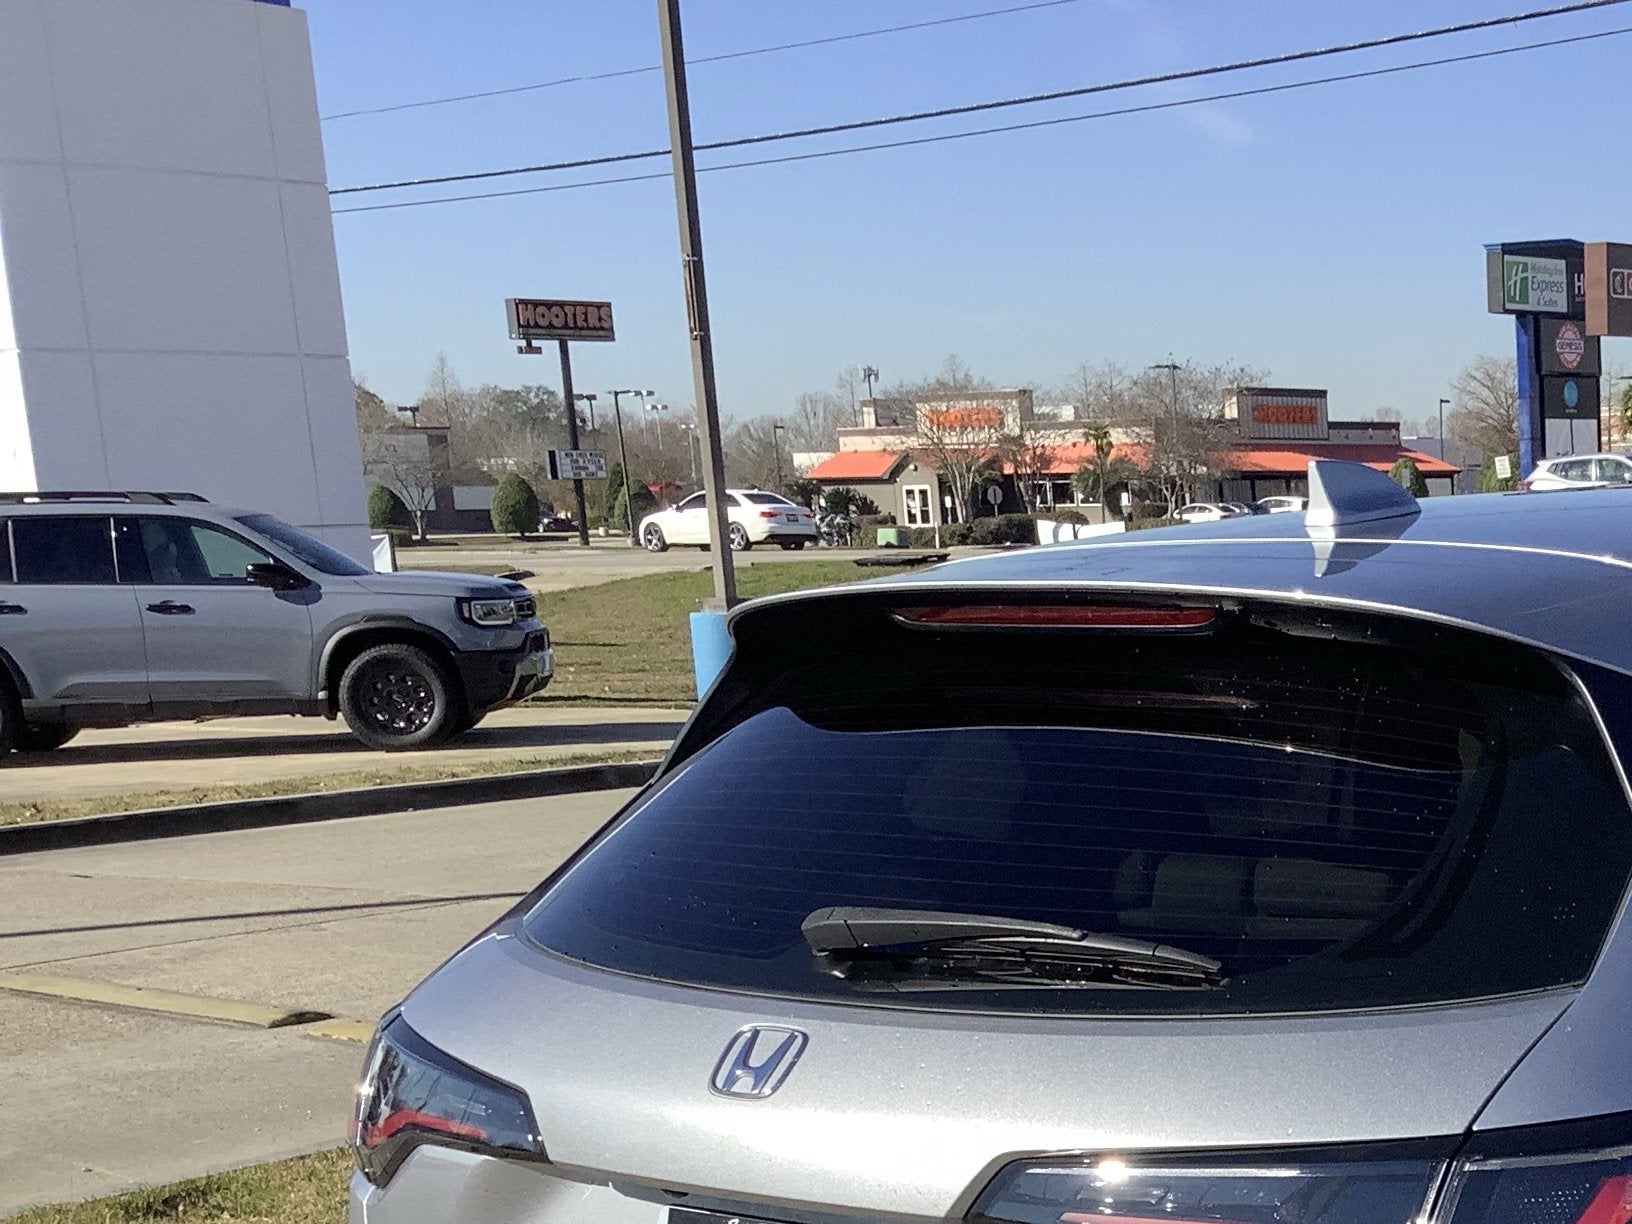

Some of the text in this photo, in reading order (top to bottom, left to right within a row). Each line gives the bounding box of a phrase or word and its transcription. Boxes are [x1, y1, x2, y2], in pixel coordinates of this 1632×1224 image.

[1530, 262, 1552, 278] Holiday
[1531, 275, 1564, 296] Express
[518, 303, 612, 329] HOOTERS
